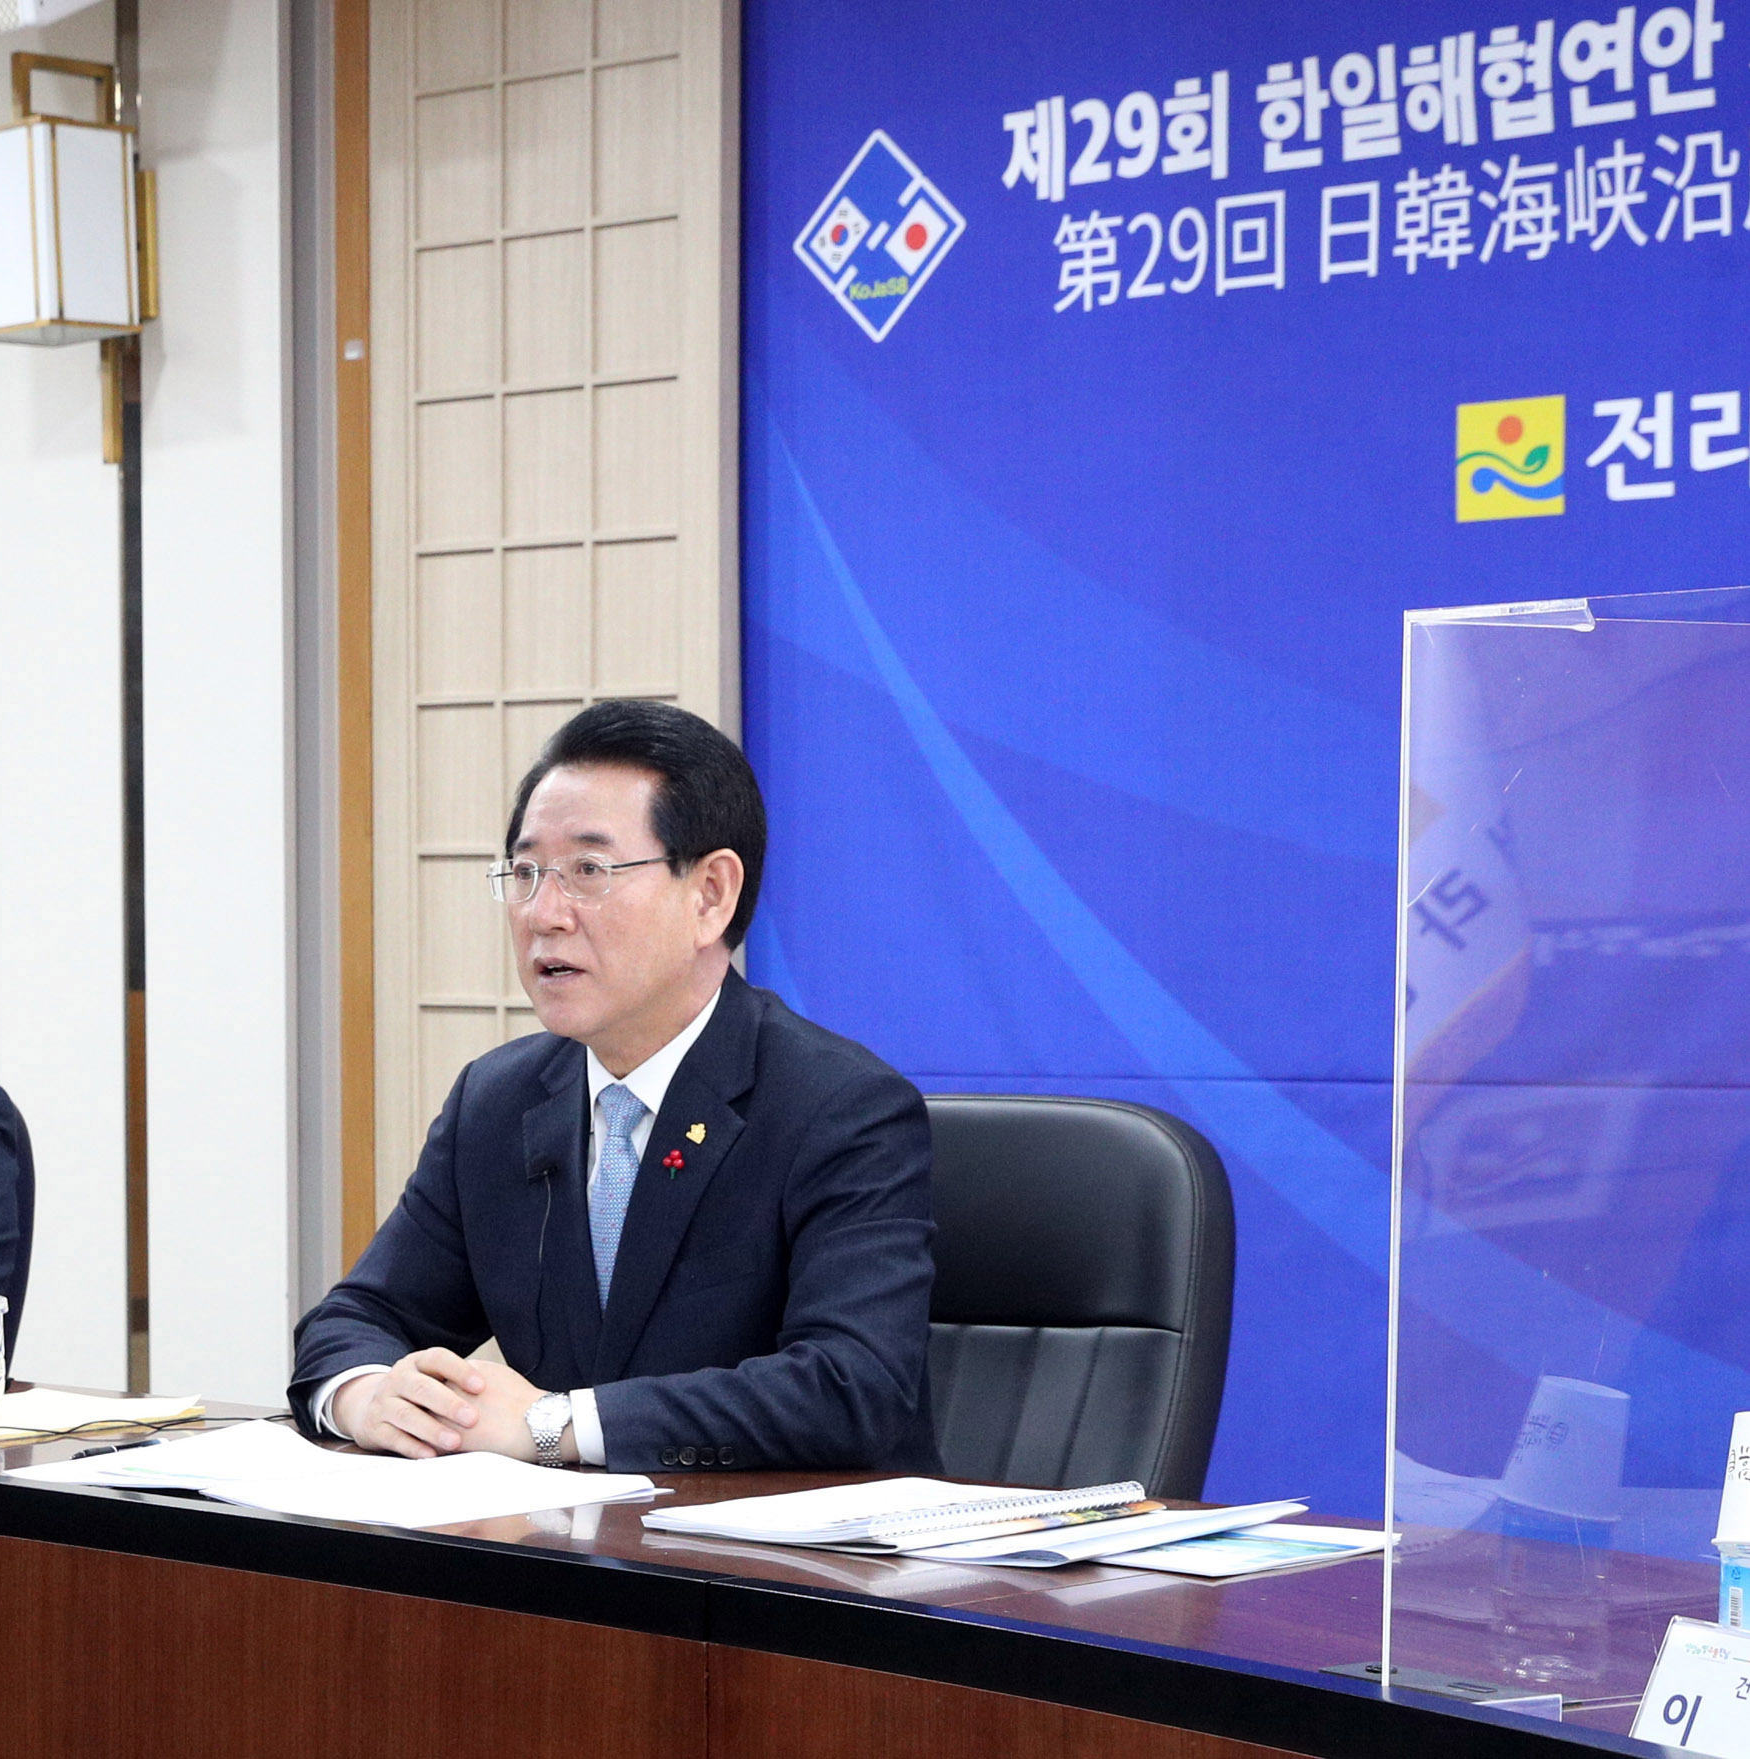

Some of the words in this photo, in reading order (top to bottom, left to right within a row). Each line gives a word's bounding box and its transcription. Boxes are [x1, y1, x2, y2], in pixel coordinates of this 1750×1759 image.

[1001, 69, 1229, 202] 제29회
[1256, 0, 1724, 173] 한일해협연안
[1052, 188, 1286, 313] 第29回
[1319, 130, 1750, 284] 日韓海峡沿
